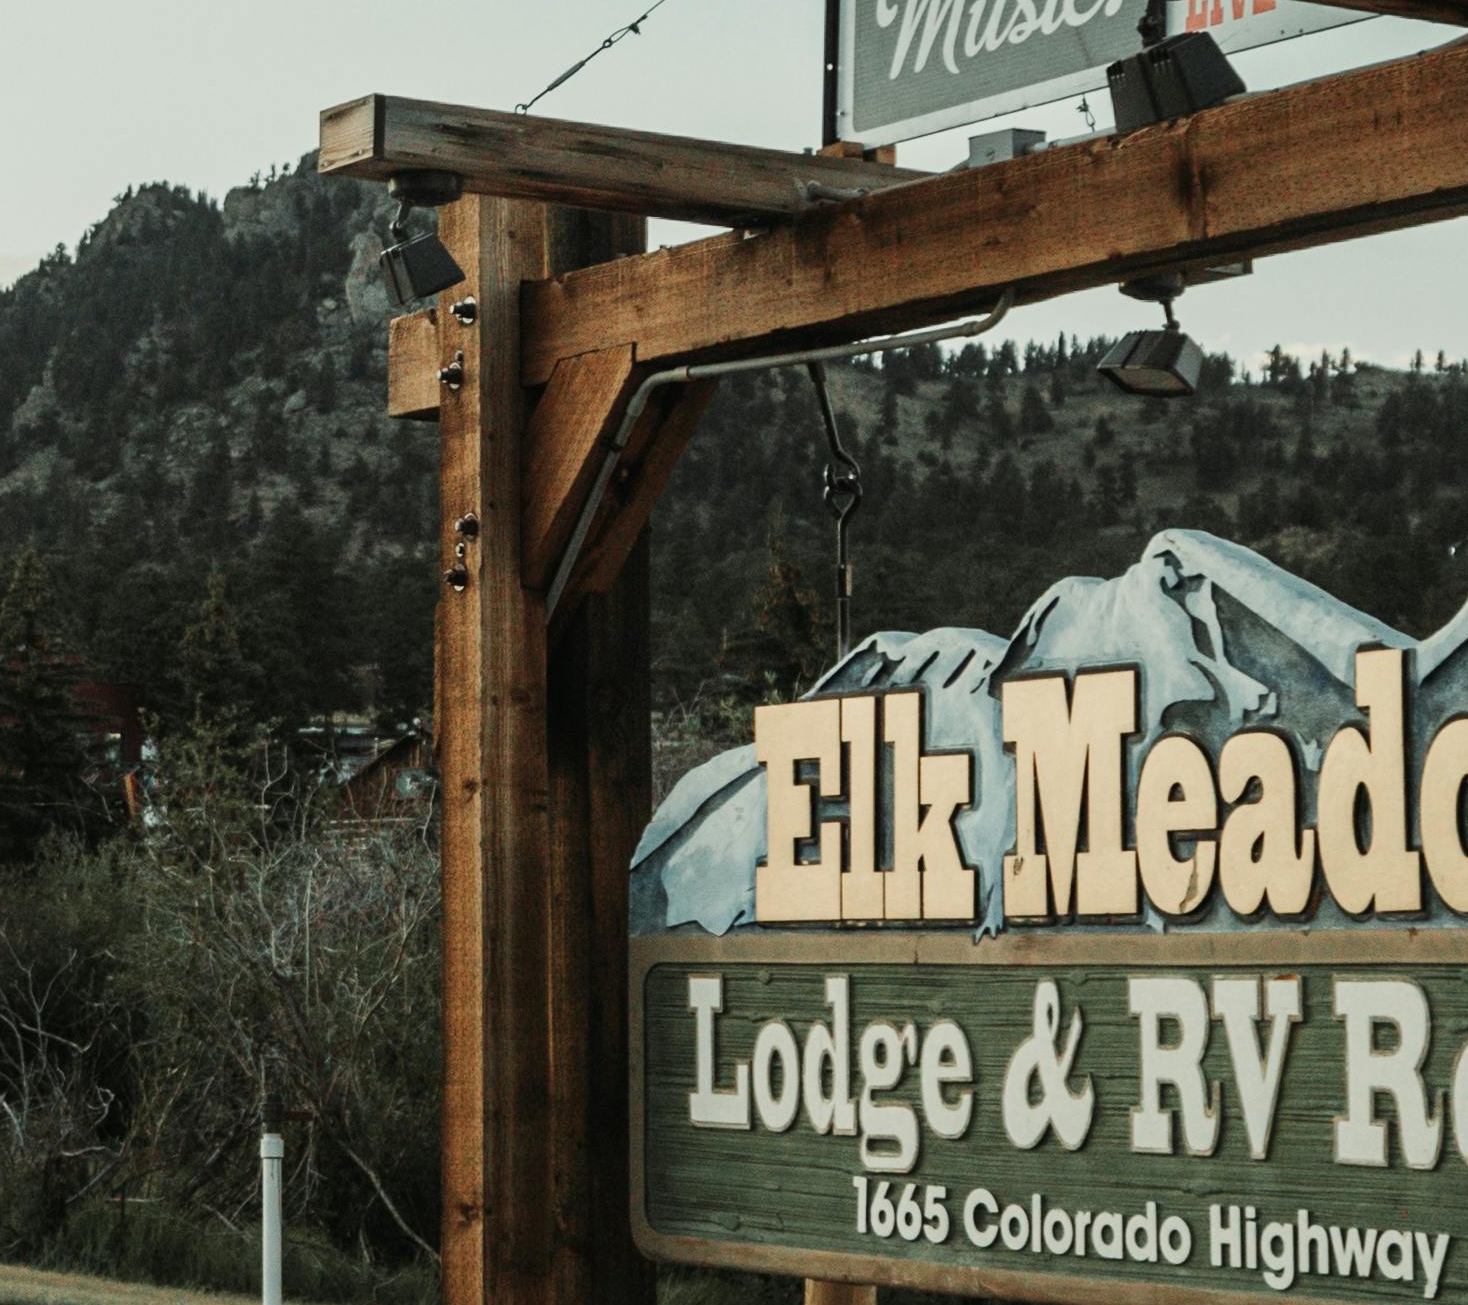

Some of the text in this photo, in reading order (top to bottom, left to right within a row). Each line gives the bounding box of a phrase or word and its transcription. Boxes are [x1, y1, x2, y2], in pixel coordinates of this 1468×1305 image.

[754, 692, 975, 922] Elk
[688, 973, 973, 1173] Lodge
[1002, 977, 1094, 1151] &
[1128, 973, 1303, 1159] RV
[853, 1176, 950, 1244] 1665
[964, 1187, 1193, 1265] Colorado
[1209, 1203, 1450, 1299] Highway
